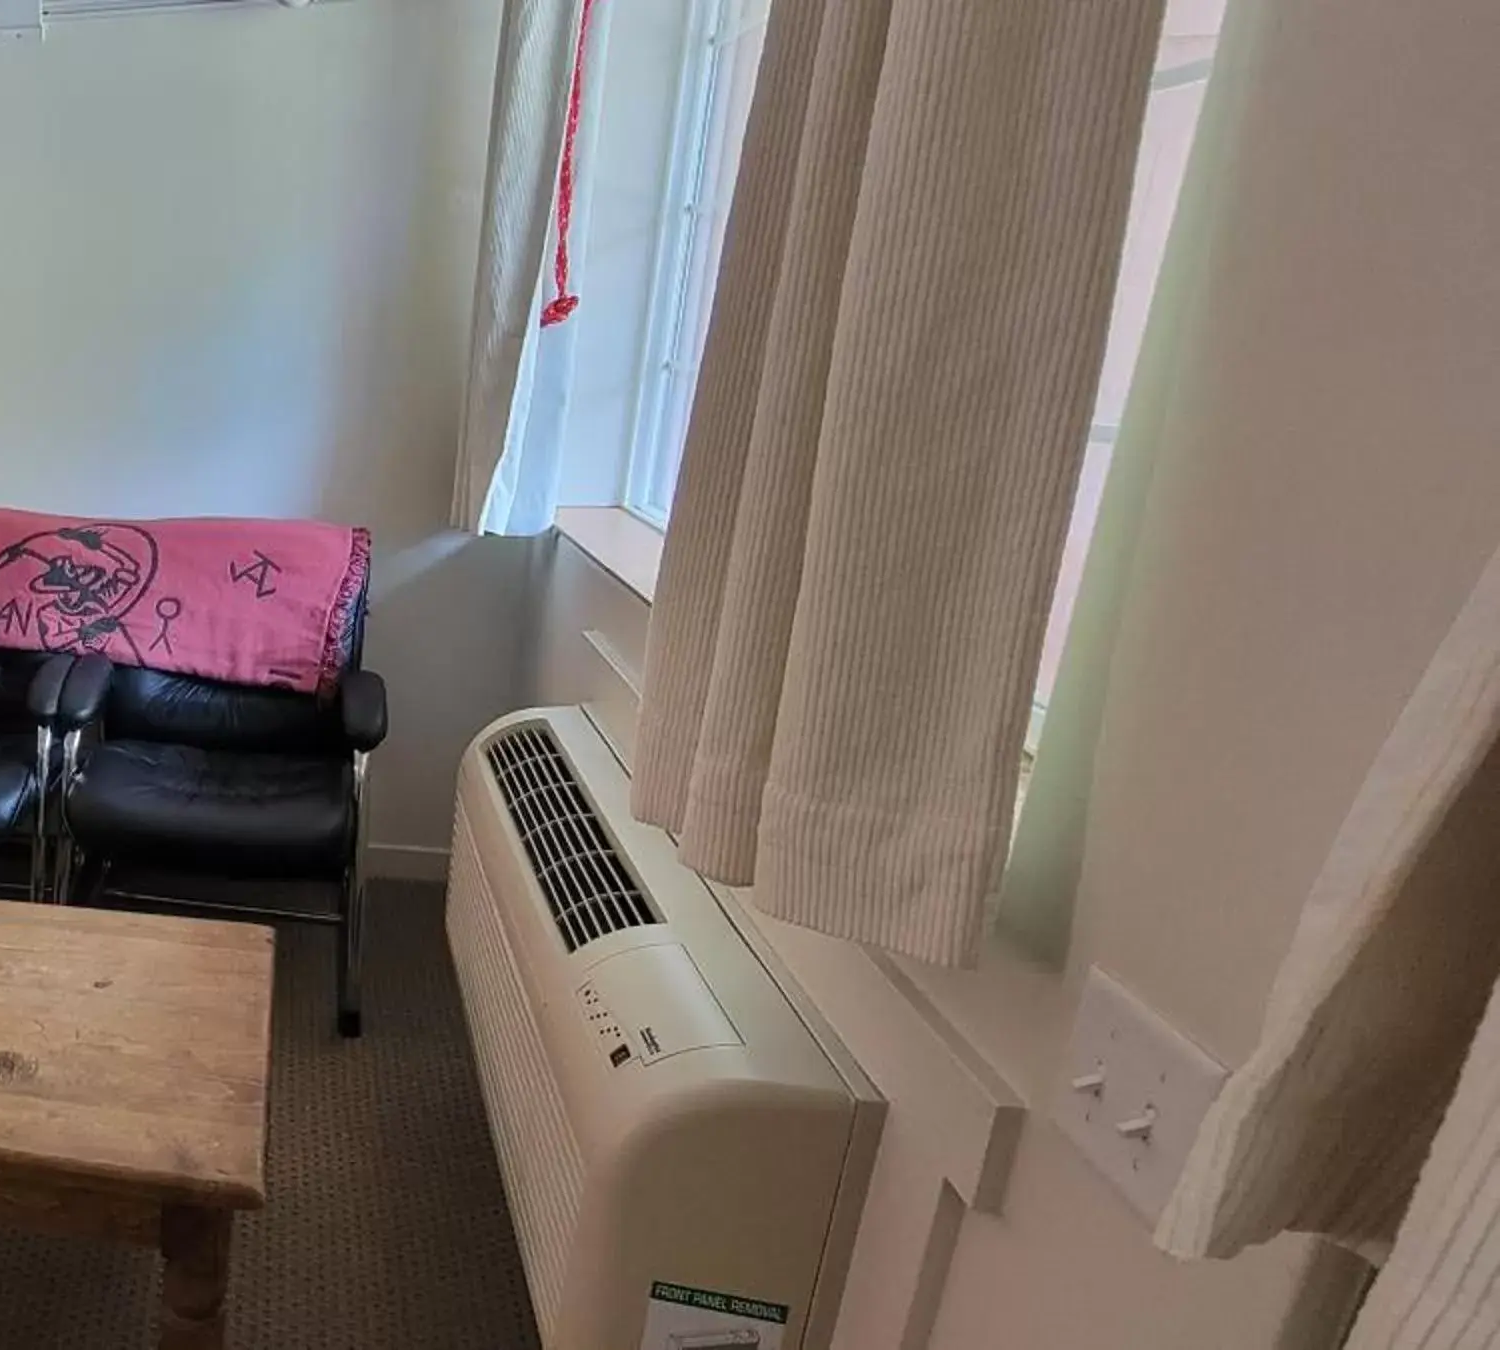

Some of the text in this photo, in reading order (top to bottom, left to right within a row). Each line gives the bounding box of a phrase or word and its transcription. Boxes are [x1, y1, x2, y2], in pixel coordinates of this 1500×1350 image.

[655, 1285, 783, 1321] FRONT PANEL REMOVAL
